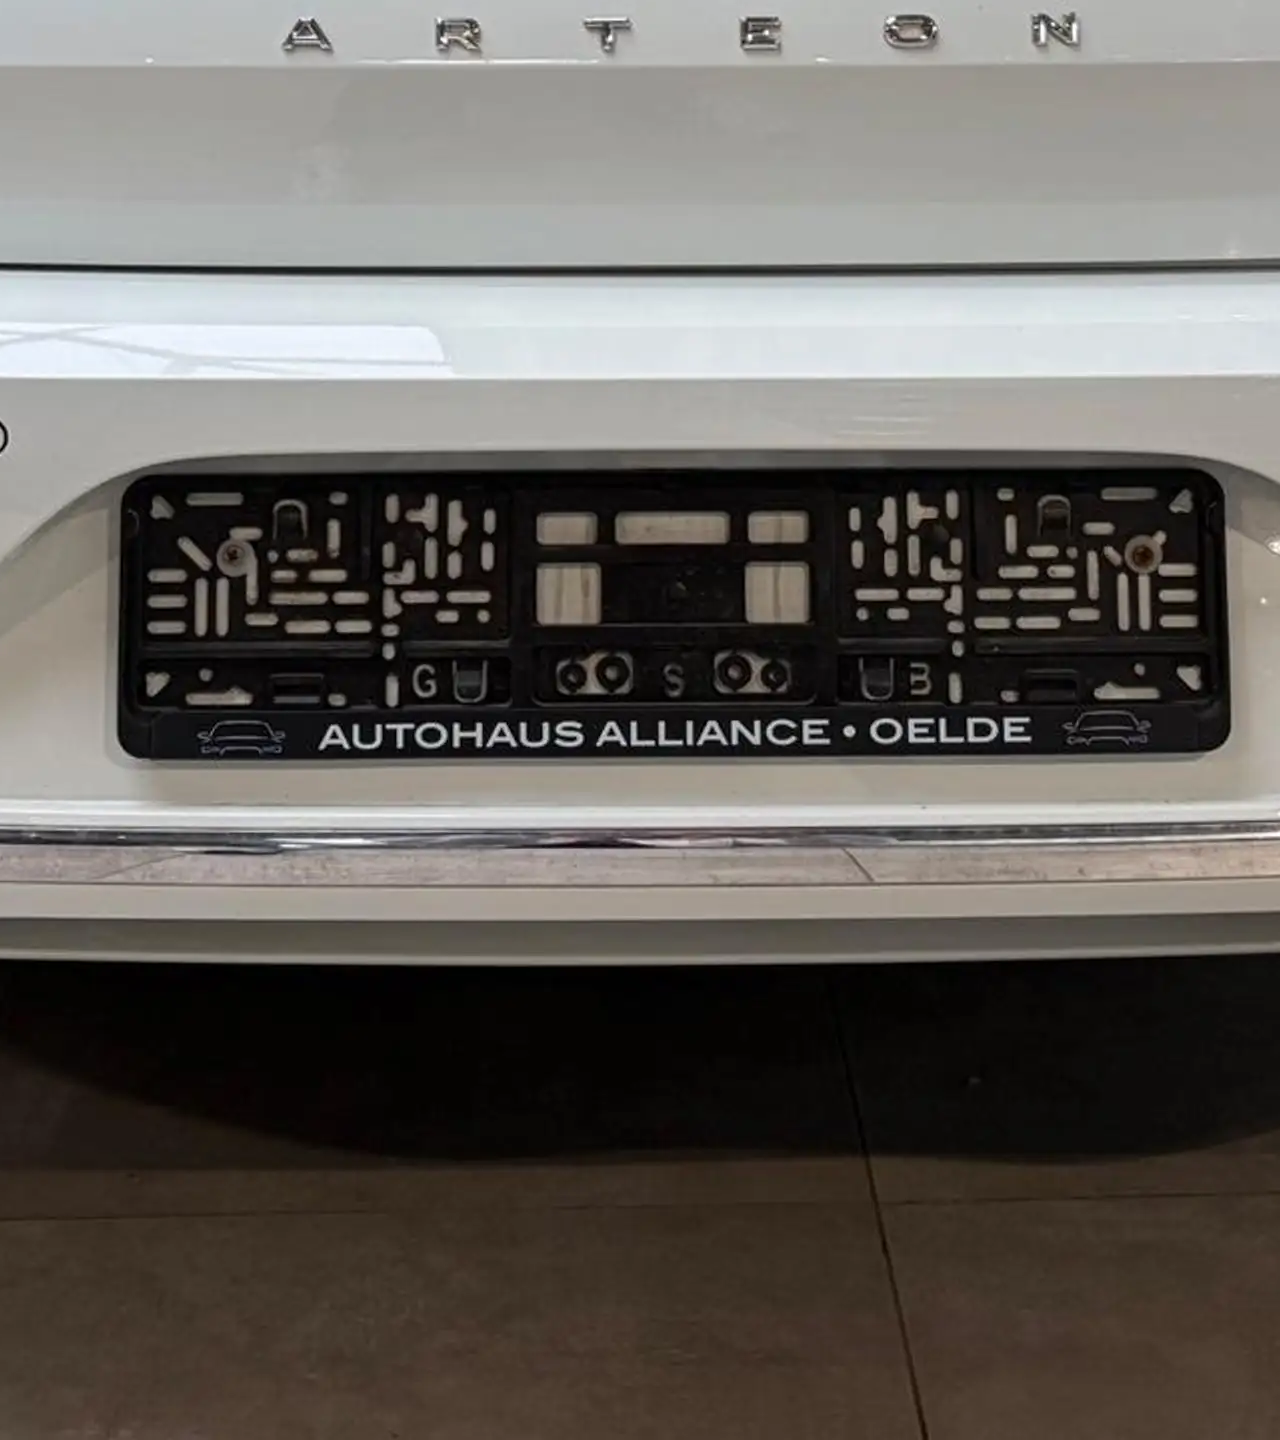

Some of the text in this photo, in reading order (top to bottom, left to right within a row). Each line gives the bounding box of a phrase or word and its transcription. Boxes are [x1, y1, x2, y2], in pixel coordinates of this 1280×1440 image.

[281, 12, 1080, 53] ARTEON
[412, 663, 437, 698] G
[663, 663, 686, 698] S
[317, 716, 1033, 751] AUTOHAUS ALLIANCE OELDE
